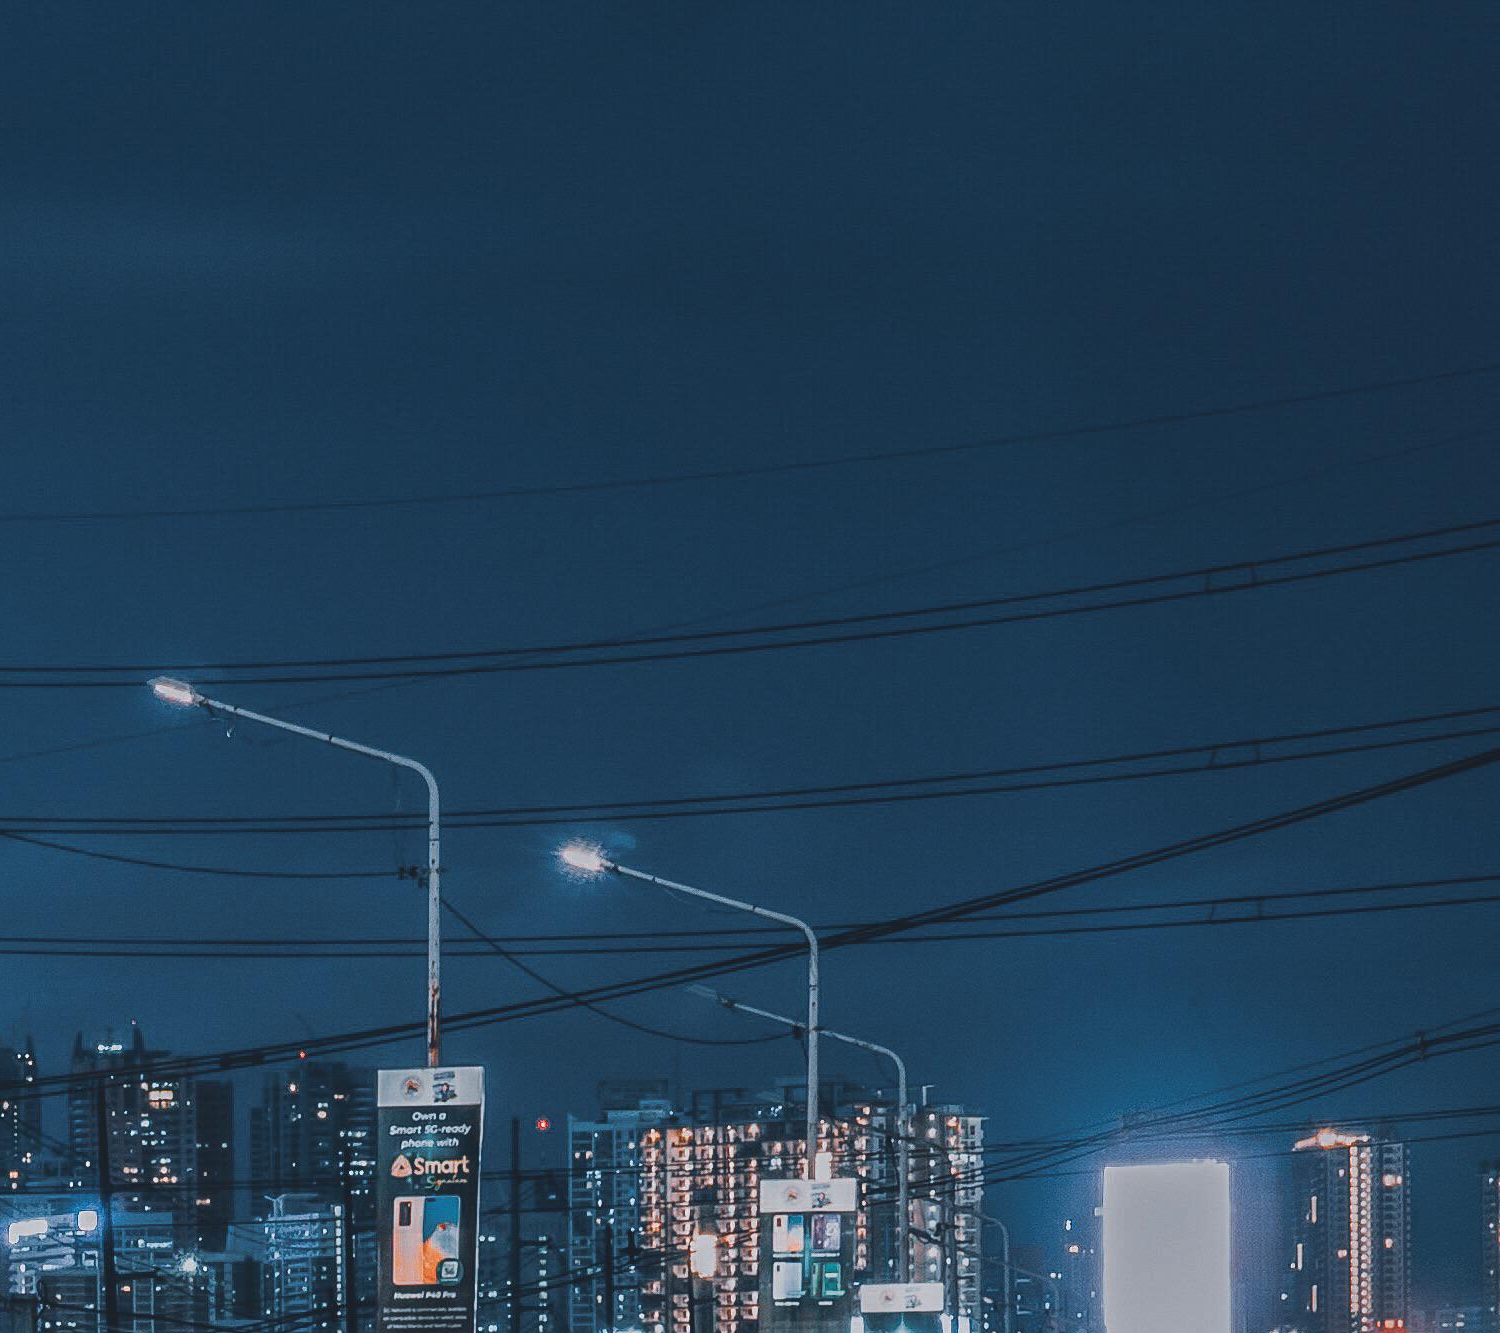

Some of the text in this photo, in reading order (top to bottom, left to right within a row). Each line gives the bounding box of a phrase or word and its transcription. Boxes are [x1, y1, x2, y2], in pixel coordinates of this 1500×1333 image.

[412, 1111, 447, 1121] Own a
[389, 1123, 472, 1136] Smart 5G-ready
[400, 1137, 459, 1150] phone with
[414, 1155, 470, 1175] Smart
